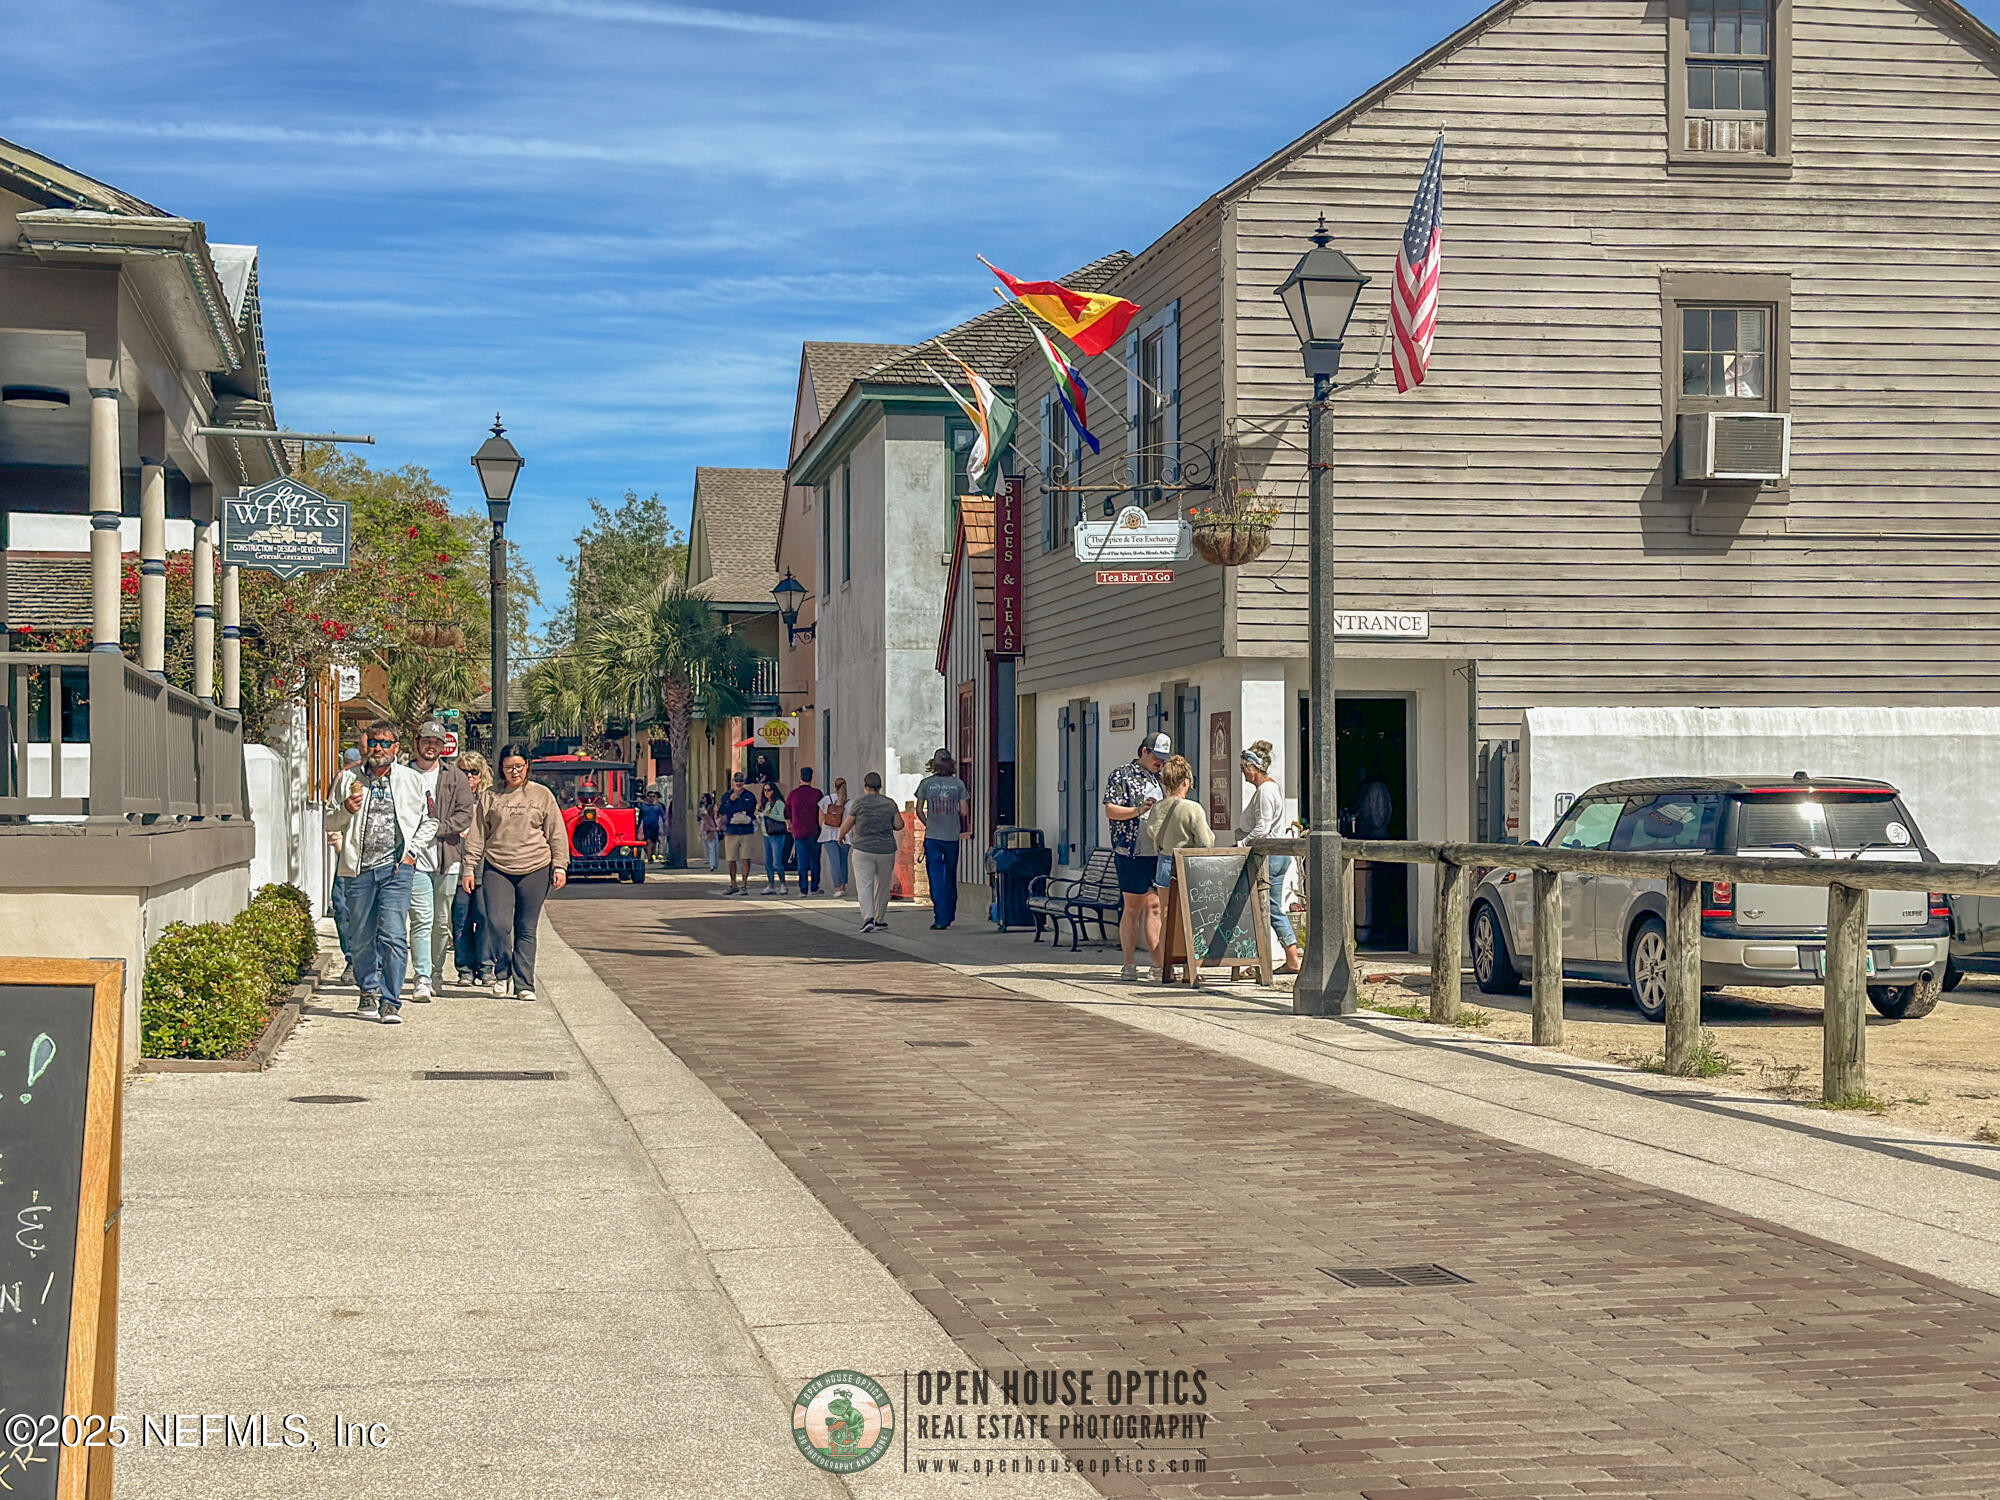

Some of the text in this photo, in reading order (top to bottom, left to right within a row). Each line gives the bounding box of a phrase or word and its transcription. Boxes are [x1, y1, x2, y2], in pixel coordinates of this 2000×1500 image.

[255, 486, 322, 511] Len
[232, 504, 339, 527] WEEKS
[1145, 535, 1177, 544] Exchange
[232, 543, 338, 555] CONSTRUCTION DESIGN DEVELOPMENT
[1003, 482, 1015, 650] SPICES & TEAS
[1101, 572, 1170, 582] Tea Bar To Go
[1334, 615, 1422, 631] NTRANCE
[757, 728, 796, 737] CUBAN
[1557, 795, 1574, 816] 17
